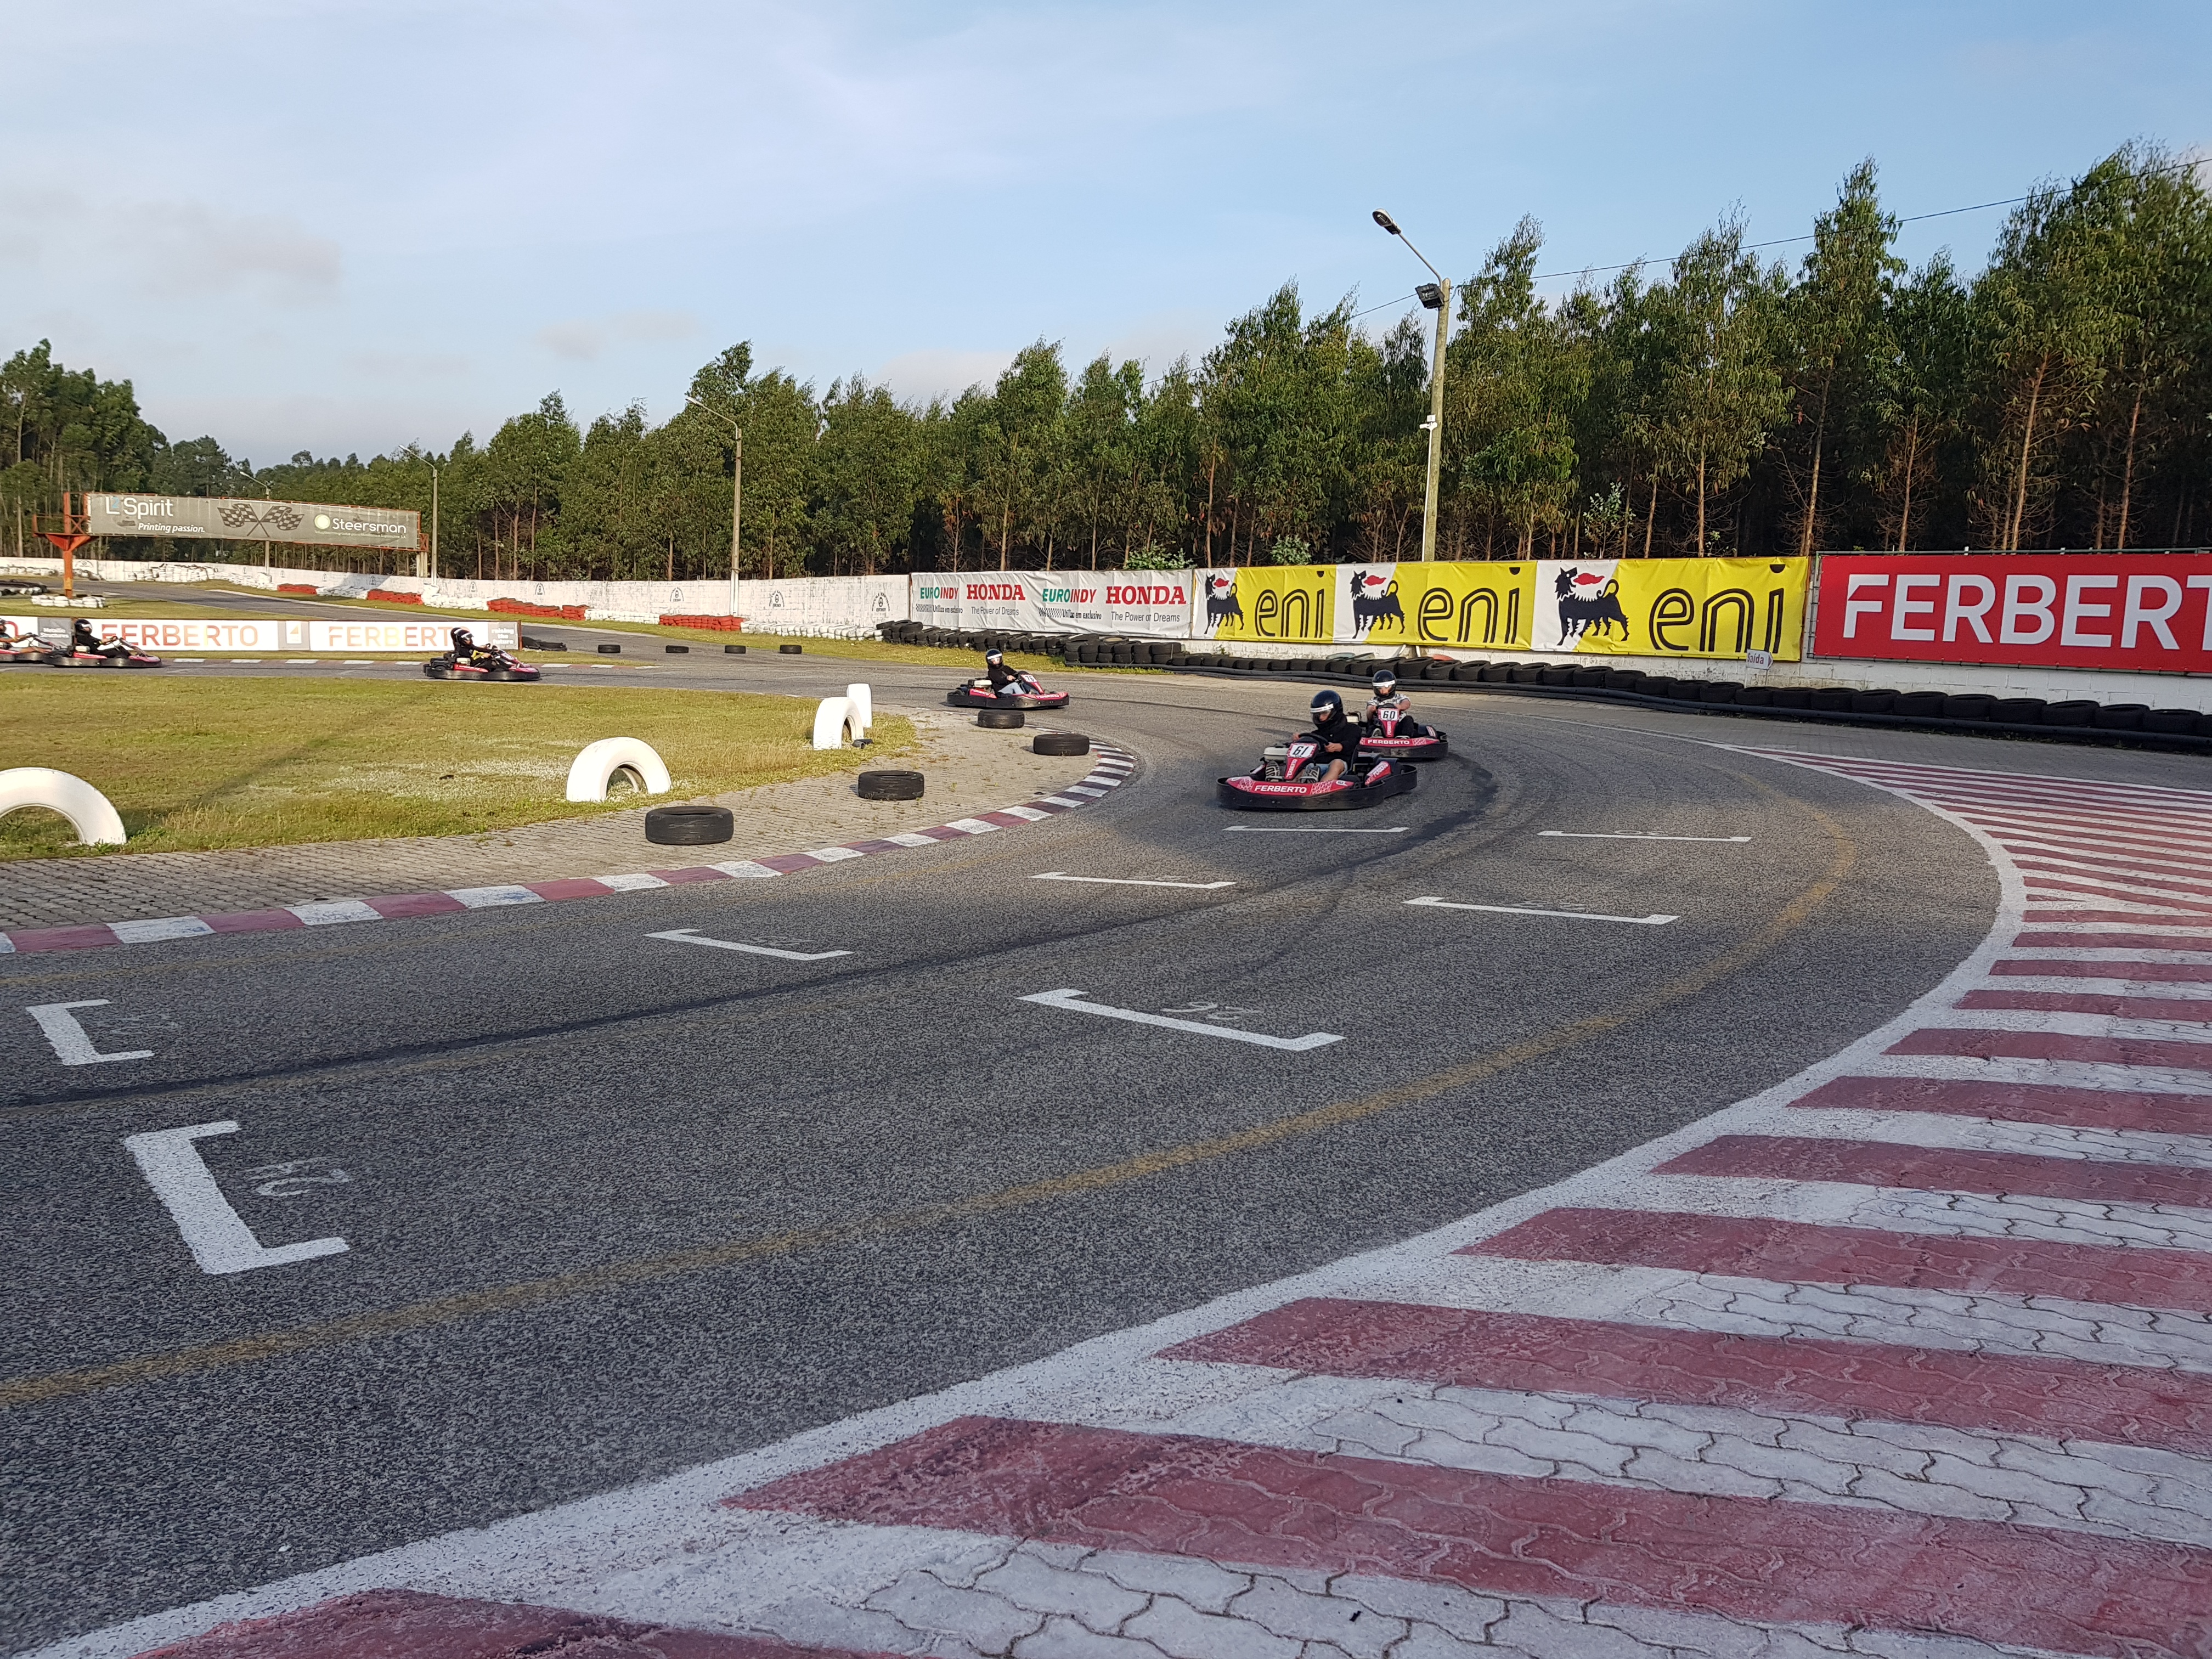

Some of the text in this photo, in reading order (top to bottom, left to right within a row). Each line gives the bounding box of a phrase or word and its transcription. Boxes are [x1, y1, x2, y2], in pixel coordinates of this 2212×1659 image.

[138, 522, 205, 534] Printing passion.
[332, 518, 407, 533] Steersman
[920, 586, 959, 600] EUROINDY
[966, 584, 1026, 600] HONDA
[1042, 588, 1097, 603] EUROINDY
[1105, 585, 1186, 604] HONDA
[971, 606, 979, 614] The
[995, 607, 1001, 615] of
[1002, 607, 1019, 616] Dreams
[1255, 571, 1325, 638] eni
[1418, 567, 1521, 644] eni
[1649, 564, 1786, 653] eni
[1083, 610, 1102, 619] exclusivo
[1111, 611, 1123, 620] The
[1125, 612, 1144, 622] Power
[1153, 612, 1180, 622] Dreams
[102, 624, 258, 647] FERBERTO
[329, 626, 470, 647] FERBERT
[1747, 652, 1764, 664] Saída
[1383, 710, 1396, 719] 60
[1292, 746, 1310, 755] 61
[1254, 785, 1307, 793] FERBERTO
